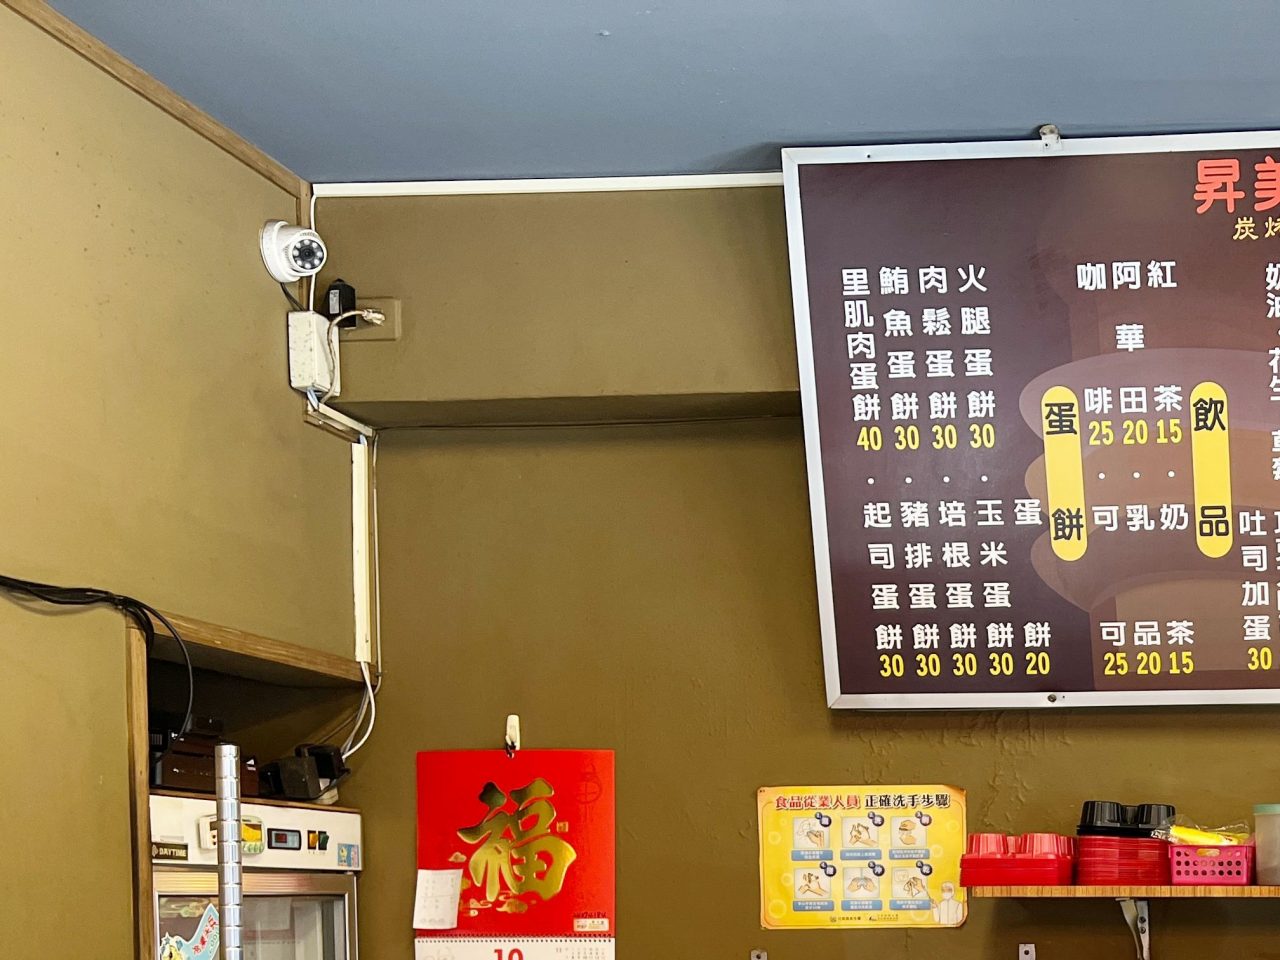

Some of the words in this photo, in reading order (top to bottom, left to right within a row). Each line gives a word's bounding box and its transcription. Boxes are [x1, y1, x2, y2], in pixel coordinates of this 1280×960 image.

[842, 267, 880, 422] 里肌肉蛋餅
[857, 425, 882, 451] 40
[894, 424, 920, 450] 30
[932, 424, 958, 449] 30
[970, 423, 995, 449] 30
[1088, 420, 1114, 446] 25
[1122, 420, 1148, 445] 20
[1156, 418, 1182, 444] 15
[1239, 510, 1271, 642] 吐司加蛋
[879, 654, 904, 678] 30
[916, 653, 941, 678] 30
[952, 653, 977, 677] 30
[989, 652, 1014, 676] 30
[1025, 651, 1050, 676] 20
[1104, 652, 1128, 676] 25
[1136, 651, 1162, 674] 20
[1168, 651, 1194, 674] 15
[1247, 647, 1272, 670] 30
[776, 795, 861, 809] 食品從業人員
[865, 794, 951, 809] 正確洗手步驟
[457, 778, 577, 901] 福
[159, 848, 187, 858] DAYTIME
